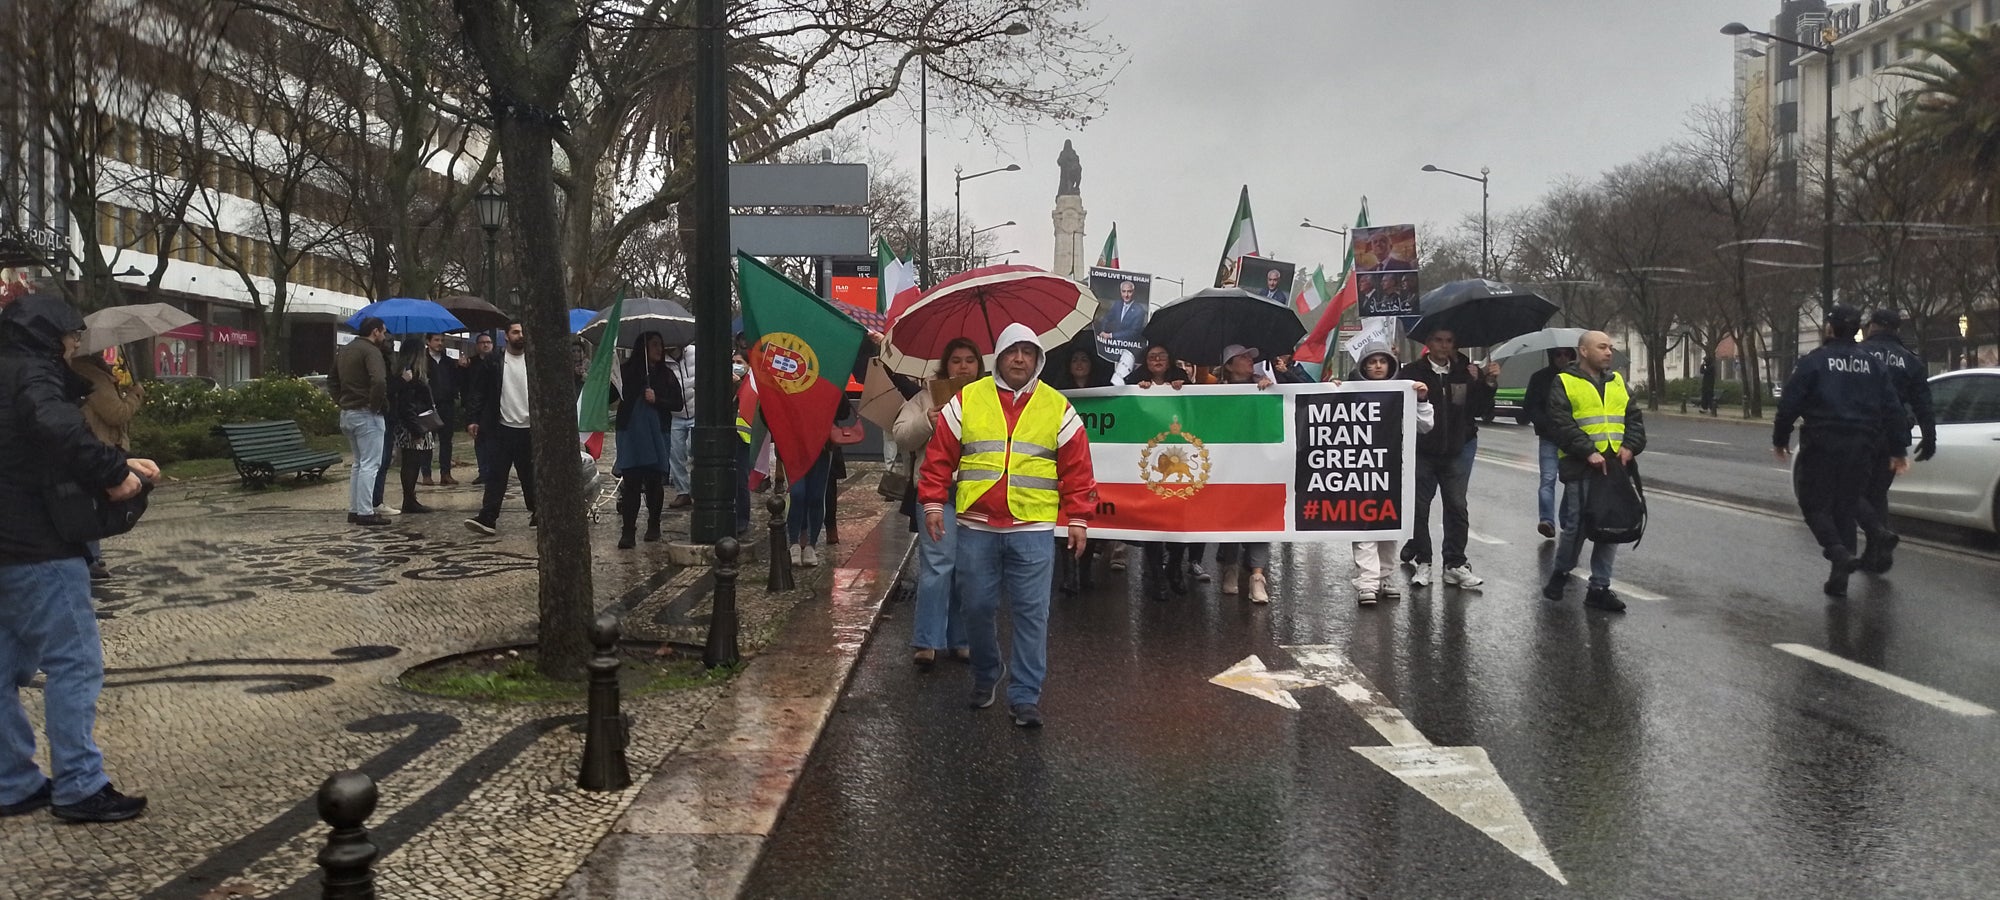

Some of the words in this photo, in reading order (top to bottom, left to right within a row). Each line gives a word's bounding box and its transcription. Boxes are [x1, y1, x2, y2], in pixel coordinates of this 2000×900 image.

[1091, 270, 1107, 278] LONG
[1108, 272, 1120, 280] LIVE
[1107, 339, 1142, 348] NATIONAL
[1828, 355, 1871, 374] POLÍCIA
[1869, 350, 1906, 368] OLÍCIA
[1078, 411, 1116, 435] mp
[1308, 402, 1381, 424] MAKE
[1309, 425, 1373, 446] IRAN
[1307, 448, 1388, 469] GREAT
[1307, 471, 1389, 492] AGAIN
[1095, 501, 1116, 515] in
[1303, 499, 1398, 522] #MIGA
